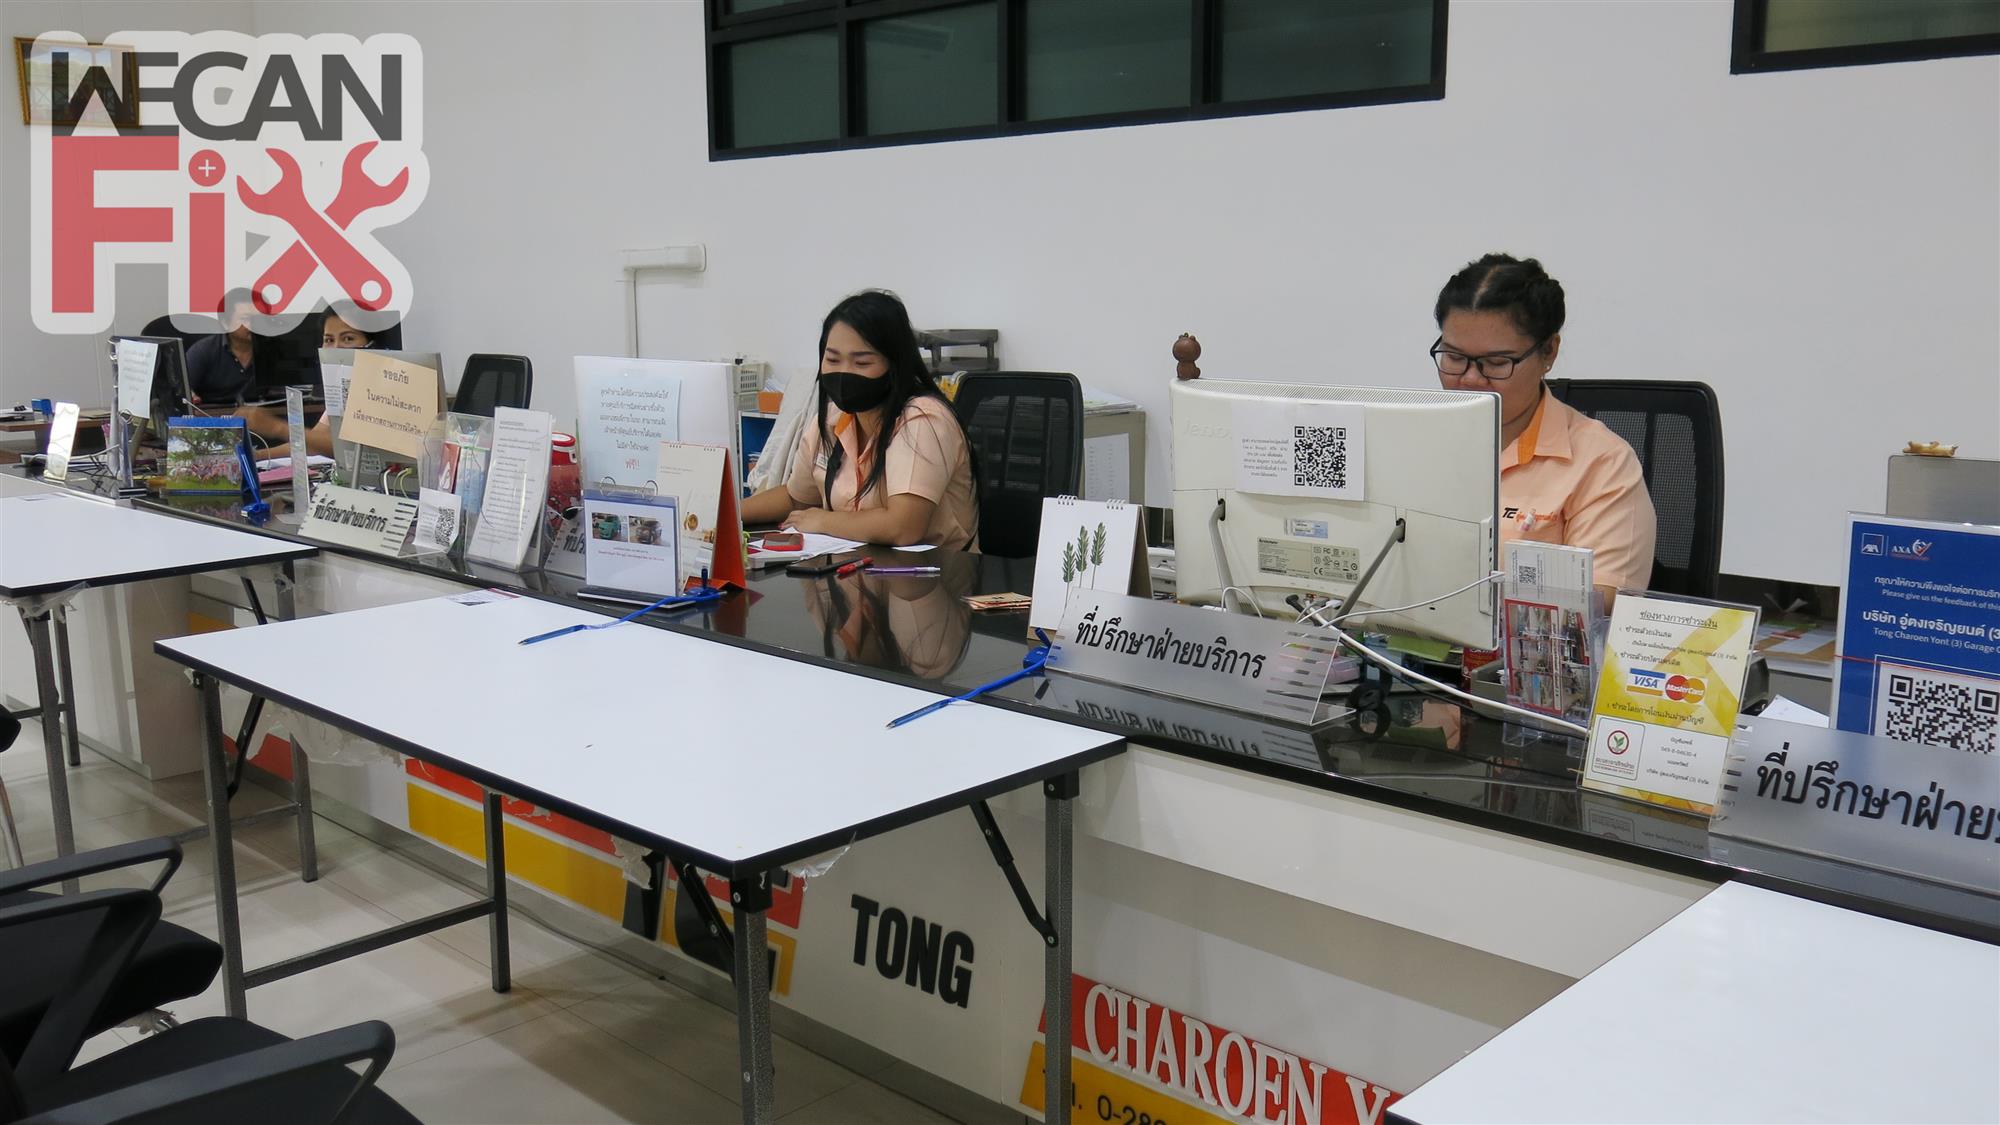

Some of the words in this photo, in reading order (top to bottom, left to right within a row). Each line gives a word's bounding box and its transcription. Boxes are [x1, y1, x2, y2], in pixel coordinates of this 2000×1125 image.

[383, 369, 410, 385] ขออภัย
[366, 388, 422, 414] ในความไม่สะดวก
[313, 493, 388, 533] ที่ปรึกษาฝ่ายบริการ
[1891, 545, 1912, 555] AXA
[1882, 589, 1905, 599] Please
[1905, 592, 1920, 602] give
[1931, 595, 1943, 604] the
[1944, 597, 1978, 608] feedback
[1978, 601, 1987, 609] of
[1625, 624, 1673, 638] ชำระด้วยเงินสด
[1639, 609, 1718, 628] ช่องทางการชำระเงิน
[1862, 609, 1896, 625] บริษัท
[1899, 613, 1986, 638] อู่ตงเจริญยนต์
[1074, 605, 1267, 680] ที่ปรึกษาฝ่ายบริการ
[1873, 628, 1894, 640] Tong
[1894, 630, 1929, 643] Charoen
[1930, 635, 1949, 646] Yont
[1951, 639, 1962, 649] (3)
[1964, 641, 1995, 654] Garage
[1633, 676, 1659, 689] VISA
[1666, 683, 1705, 696] MasterCard
[1756, 741, 2000, 846] ที่ปรึกษาฝ่าย
[850, 894, 975, 1009] TONG
[1084, 983, 1328, 1125] CHAROEN
